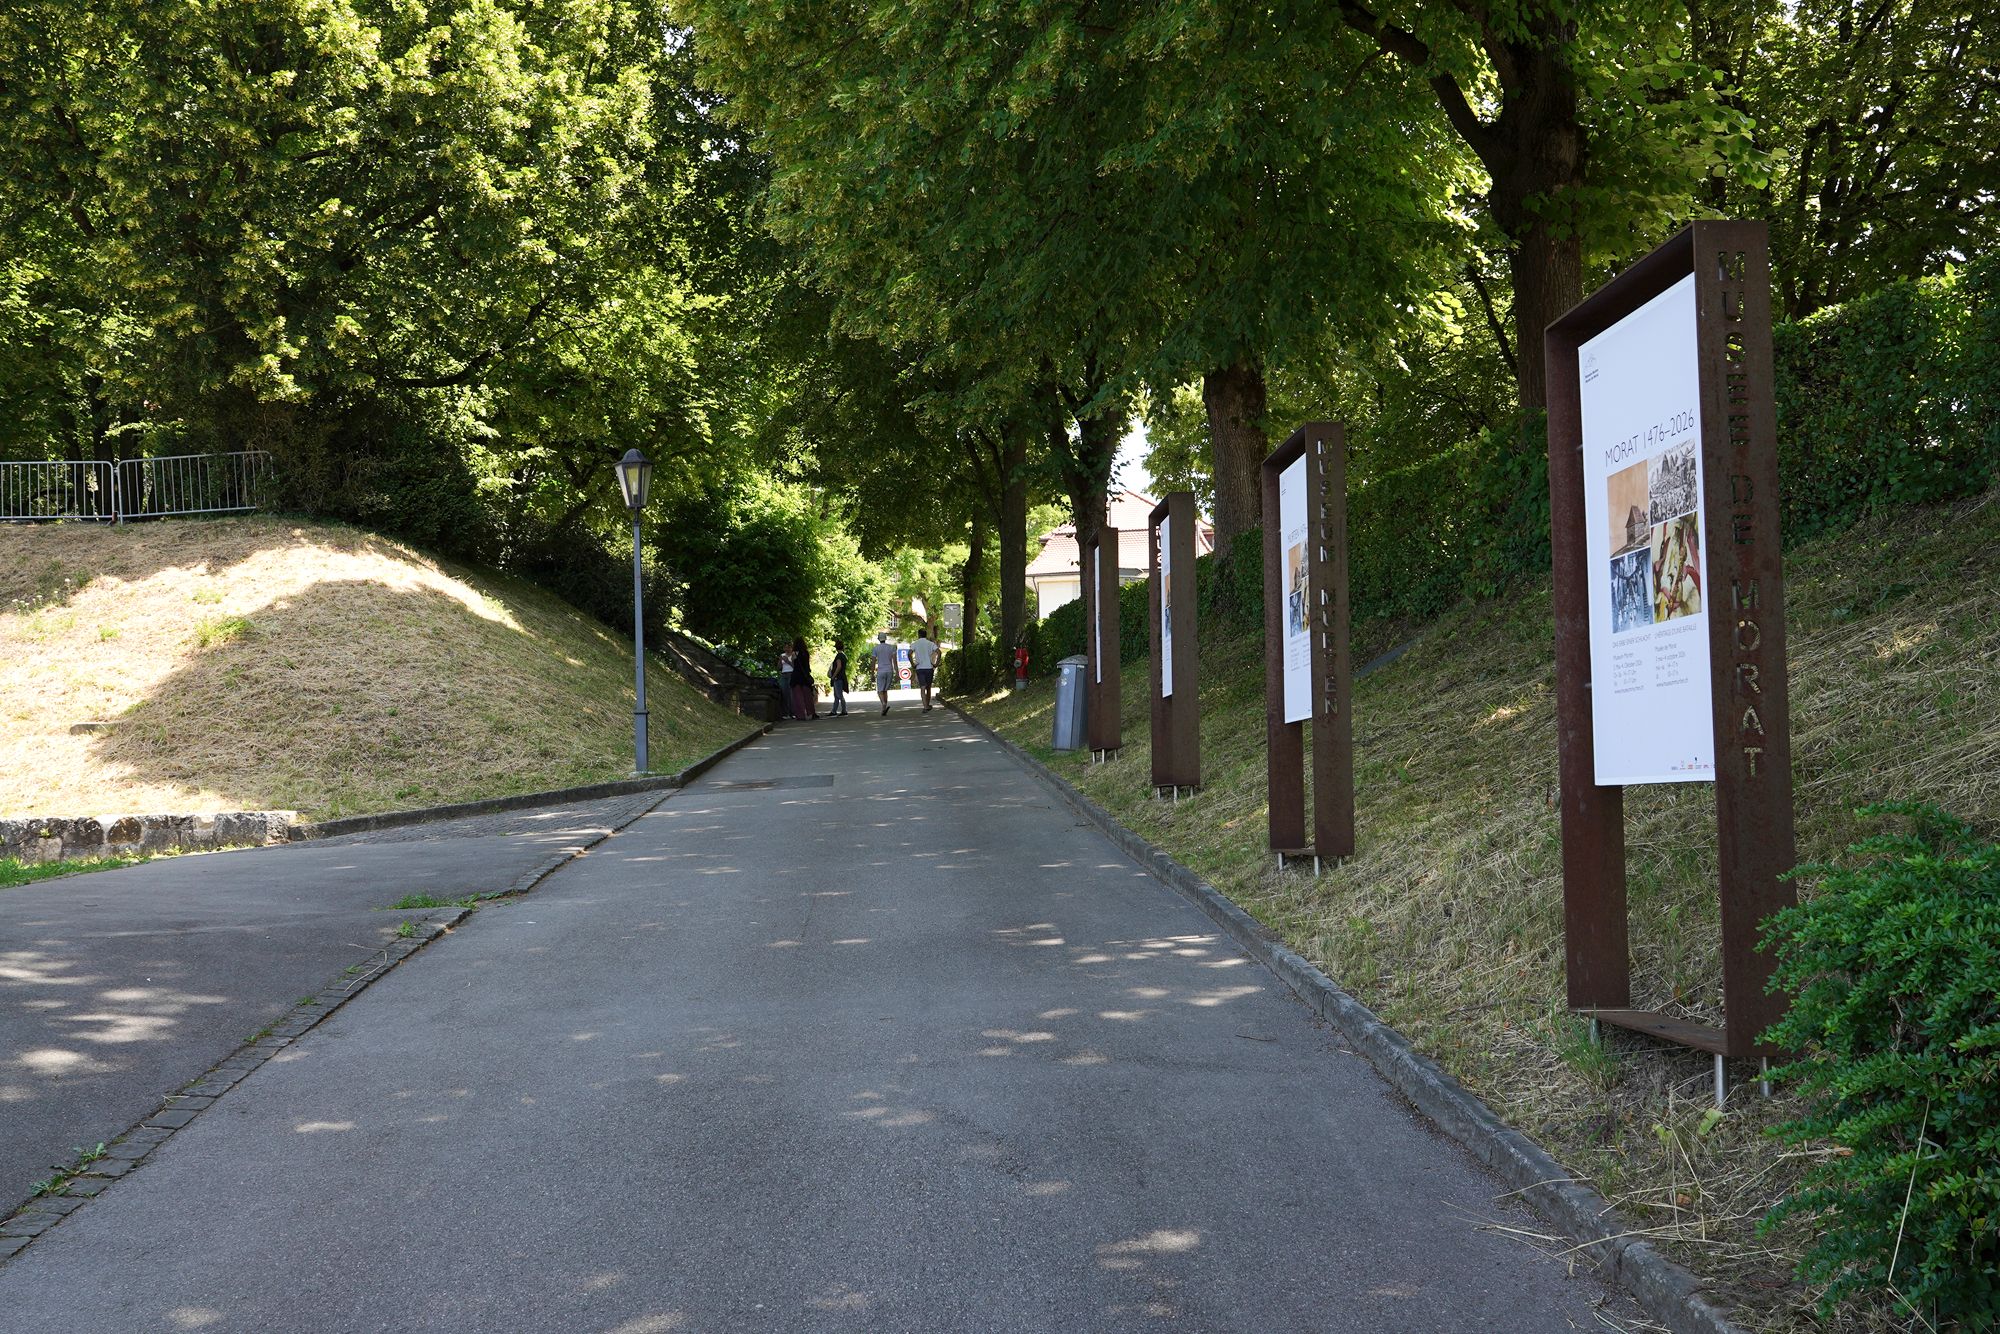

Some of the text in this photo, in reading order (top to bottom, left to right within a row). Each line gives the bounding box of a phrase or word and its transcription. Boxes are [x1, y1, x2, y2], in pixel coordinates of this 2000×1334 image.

[1605, 434, 1639, 468] MORAT
[1731, 475, 1754, 545] DE
[901, 650, 907, 659] P
[1732, 579, 1765, 778] MORAT
